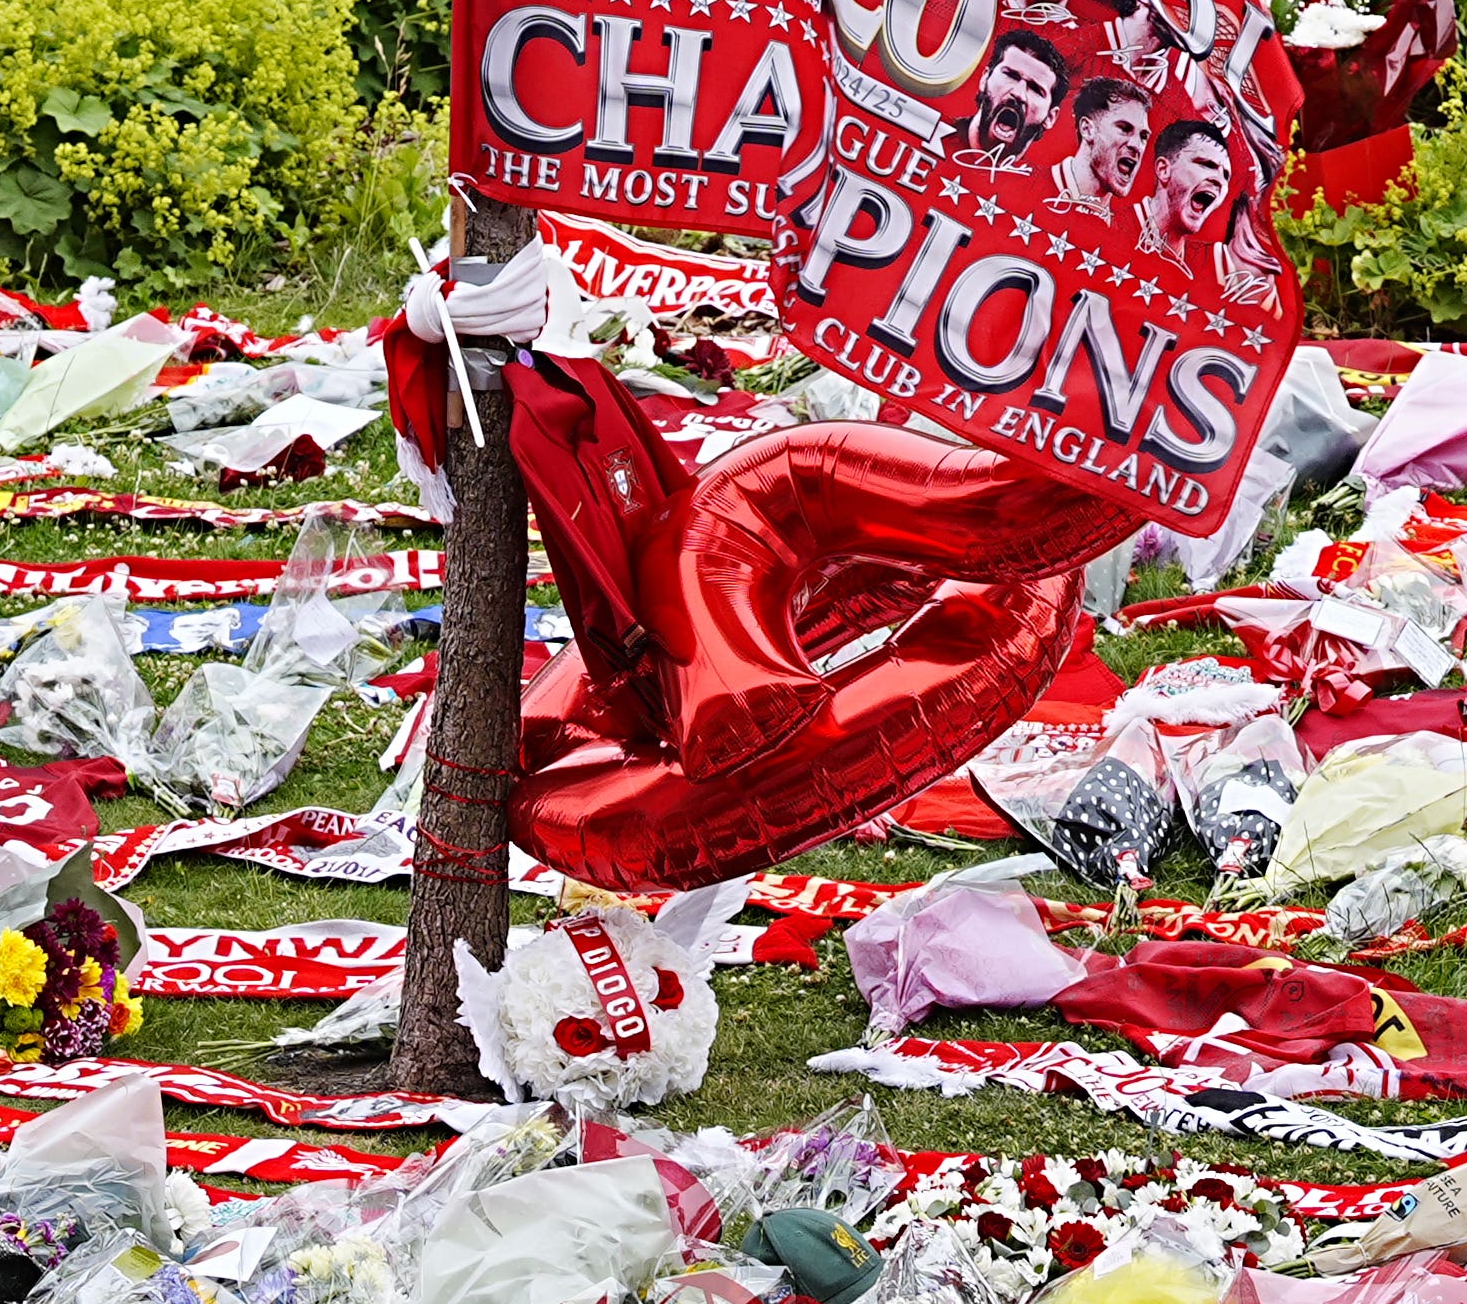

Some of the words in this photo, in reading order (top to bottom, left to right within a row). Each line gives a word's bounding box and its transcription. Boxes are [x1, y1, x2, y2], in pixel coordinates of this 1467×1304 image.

[830, 58, 908, 119] 024/25
[485, 144, 562, 192] THE
[579, 162, 709, 212] MOST
[836, 114, 938, 194] GUE
[814, 316, 921, 400] CLUB
[932, 381, 987, 425] IN
[990, 401, 1212, 519] ENGLAND
[300, 809, 357, 835] PEAN
[581, 945, 644, 1040] DIOGO
